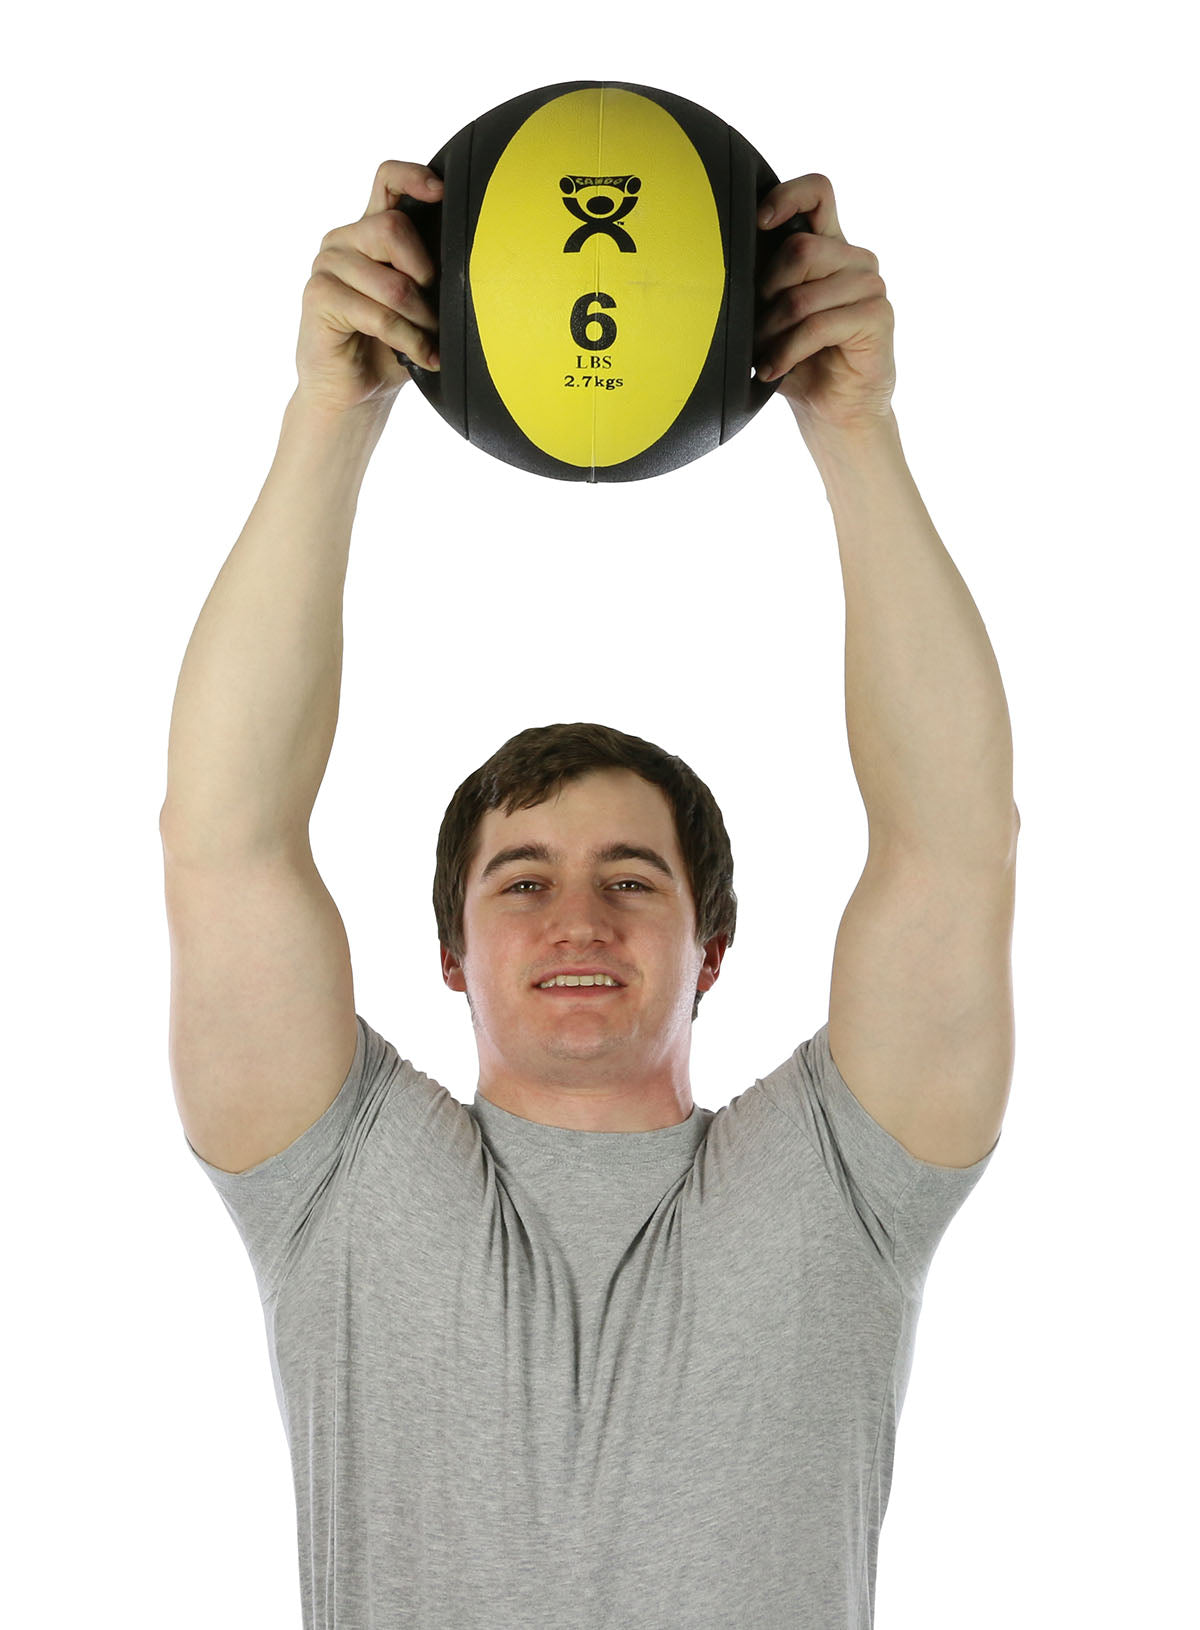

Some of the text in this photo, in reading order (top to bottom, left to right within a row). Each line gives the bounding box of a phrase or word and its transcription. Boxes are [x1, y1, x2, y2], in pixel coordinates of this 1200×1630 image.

[570, 292, 617, 351] 6
[576, 355, 612, 369] LBS
[564, 375, 624, 390] 2.7kgs
